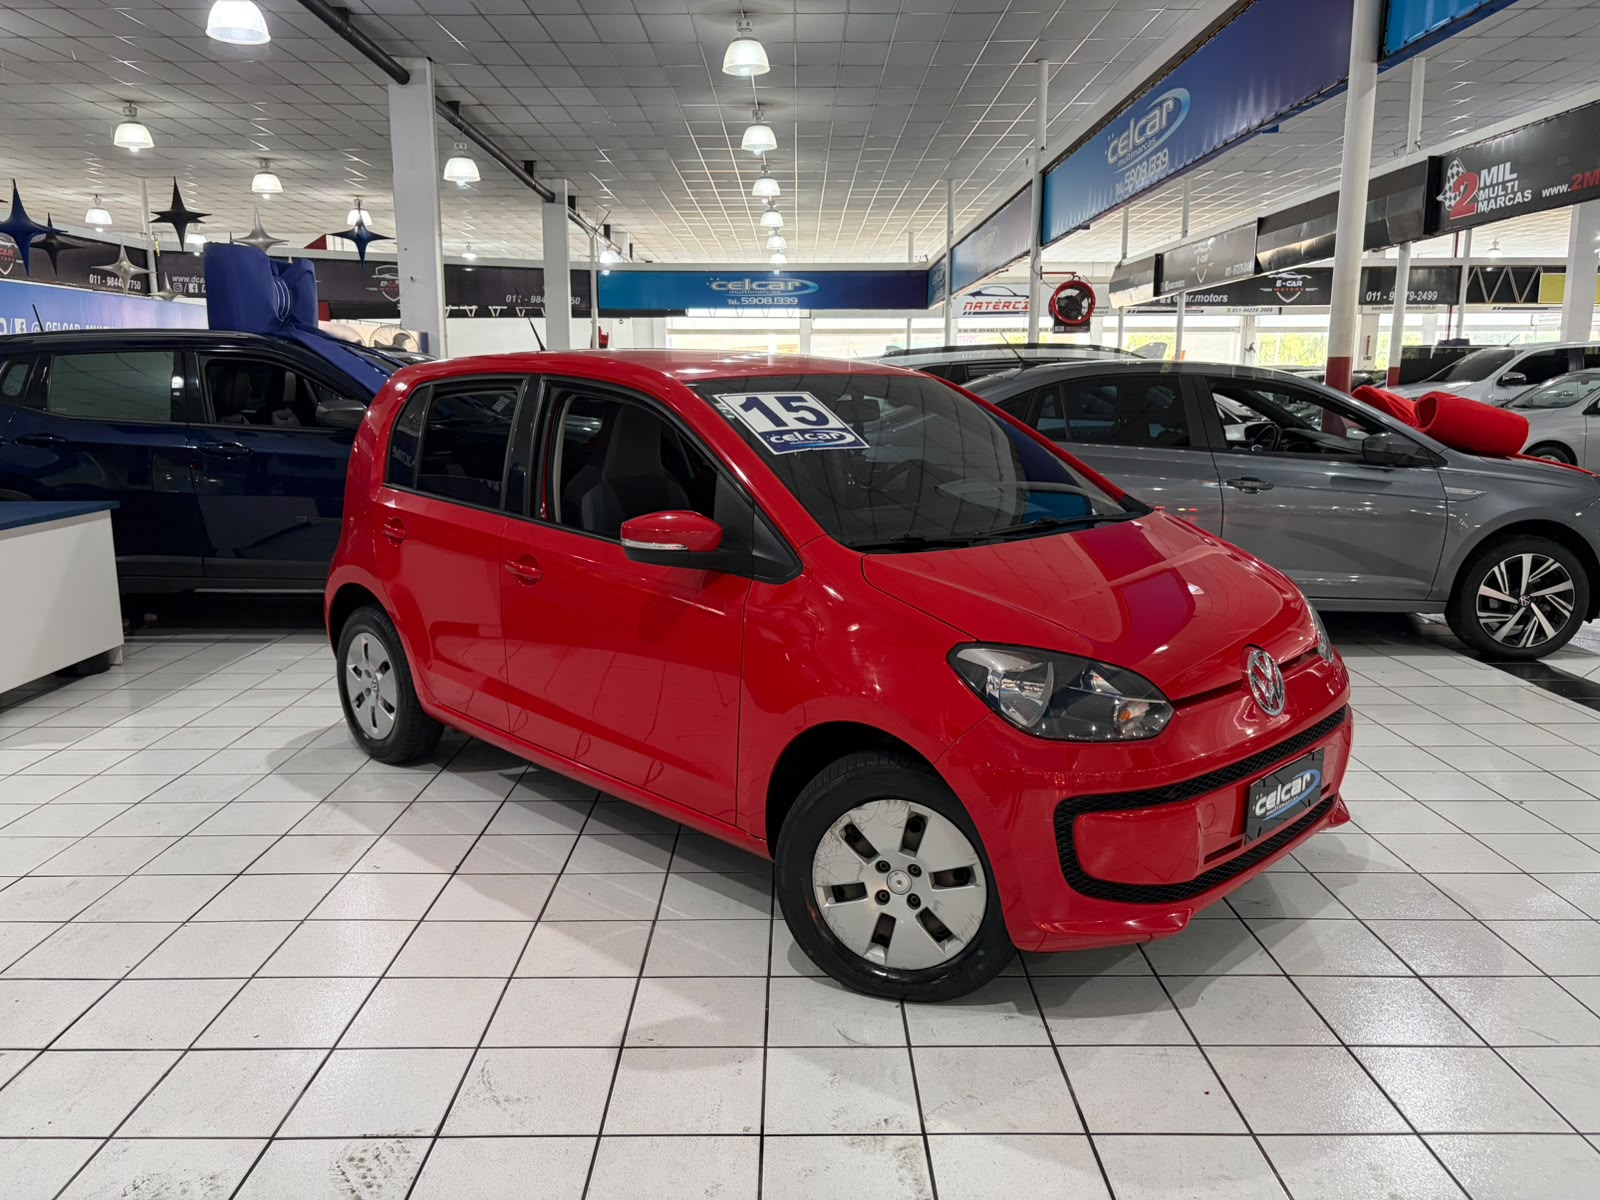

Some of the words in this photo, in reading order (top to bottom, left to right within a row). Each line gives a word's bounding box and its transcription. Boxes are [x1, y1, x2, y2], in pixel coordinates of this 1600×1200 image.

[1107, 97, 1175, 165] celcar
[1480, 161, 1518, 188] MIL
[1478, 189, 1532, 213] MARCAS
[1479, 180, 1519, 202] MULTI
[89, 273, 101, 284] 011
[711, 278, 802, 291] celcar
[1366, 291, 1381, 302] 011
[738, 395, 830, 428] 15
[769, 431, 842, 444] celcar
[1254, 772, 1312, 817] celcar
